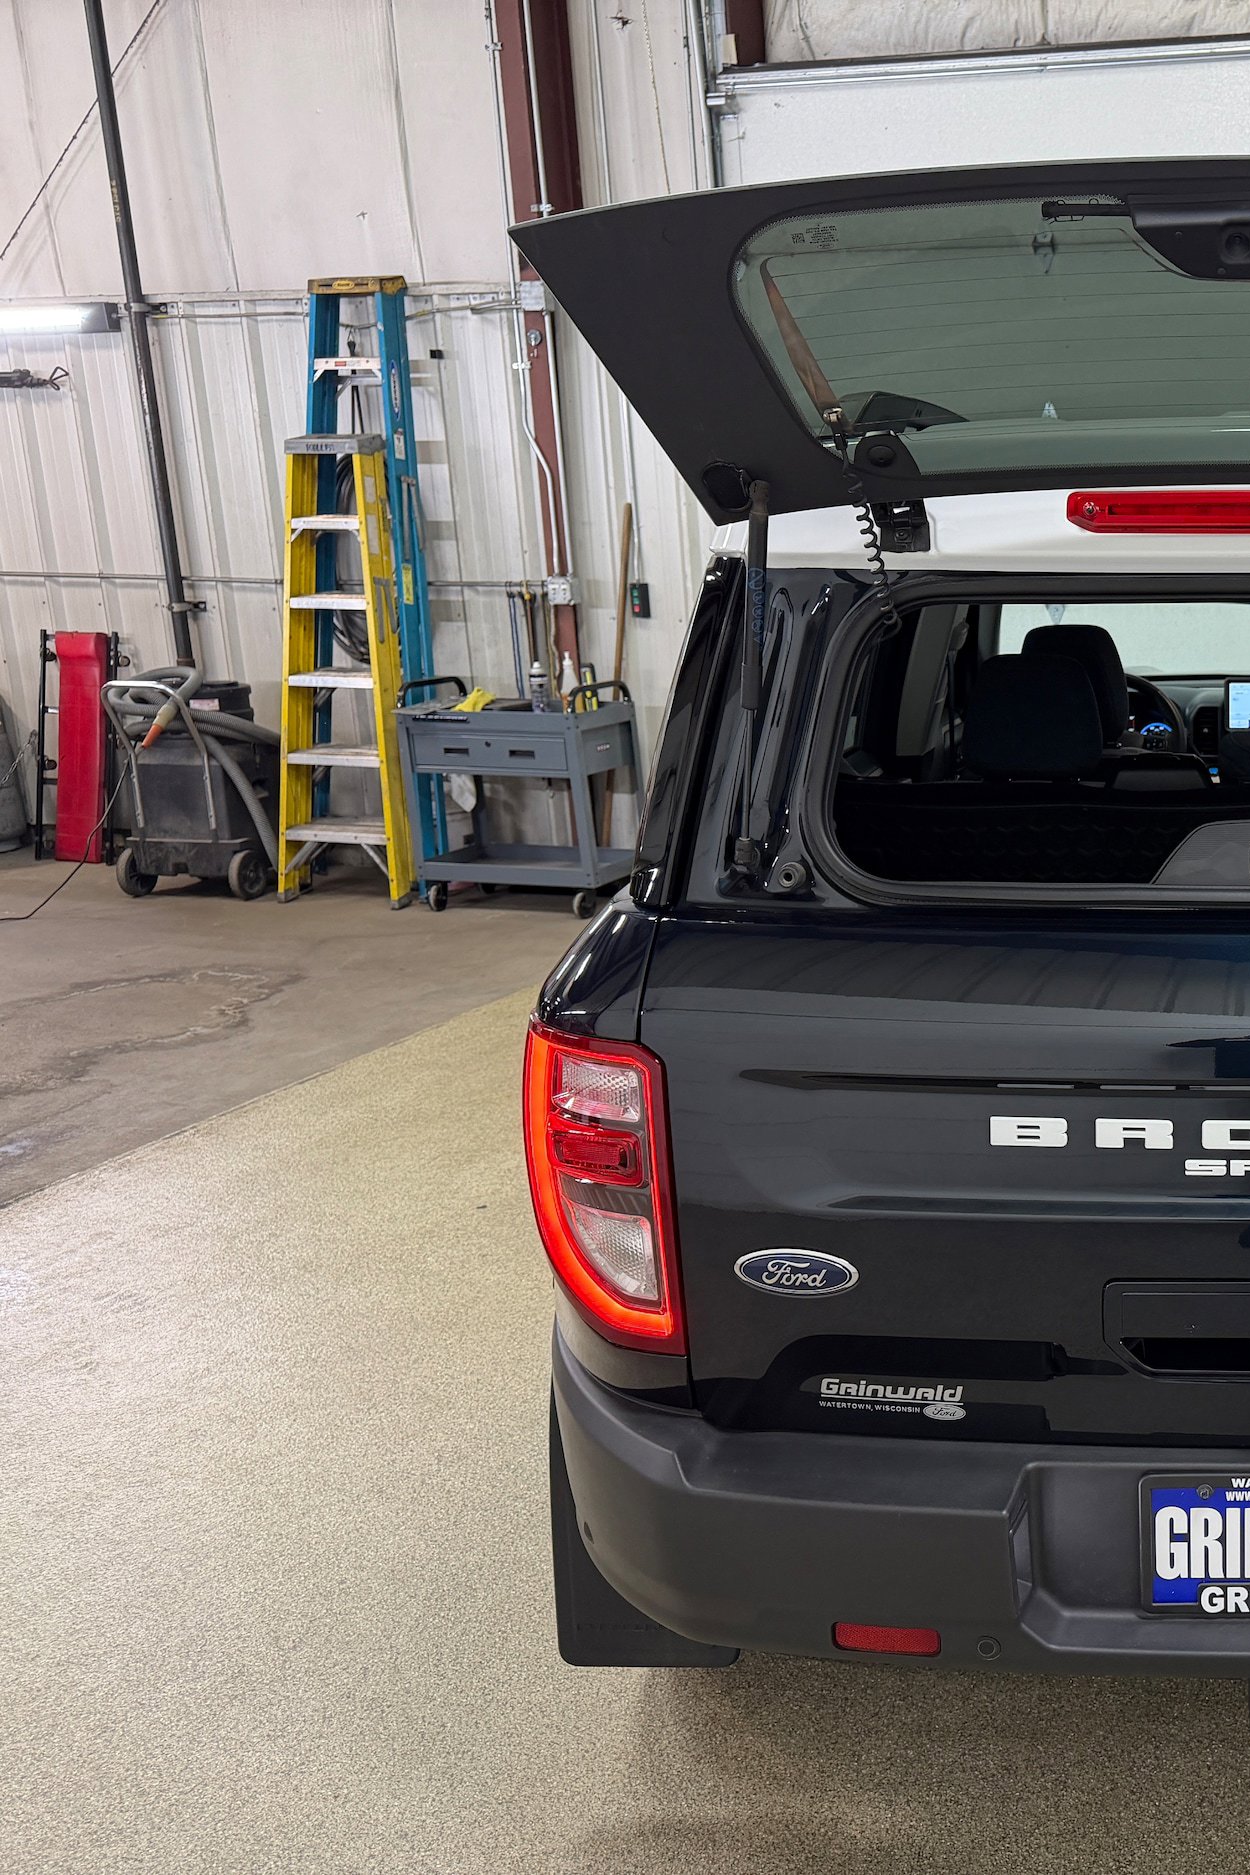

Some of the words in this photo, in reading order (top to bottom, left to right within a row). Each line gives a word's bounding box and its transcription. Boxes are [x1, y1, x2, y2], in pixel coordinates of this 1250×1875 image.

[762, 1259, 828, 1288] Ford
[819, 1400, 873, 1411] WATERTOWN,
[874, 1403, 921, 1414] WISCONSIN
[931, 1406, 958, 1418] Ford
